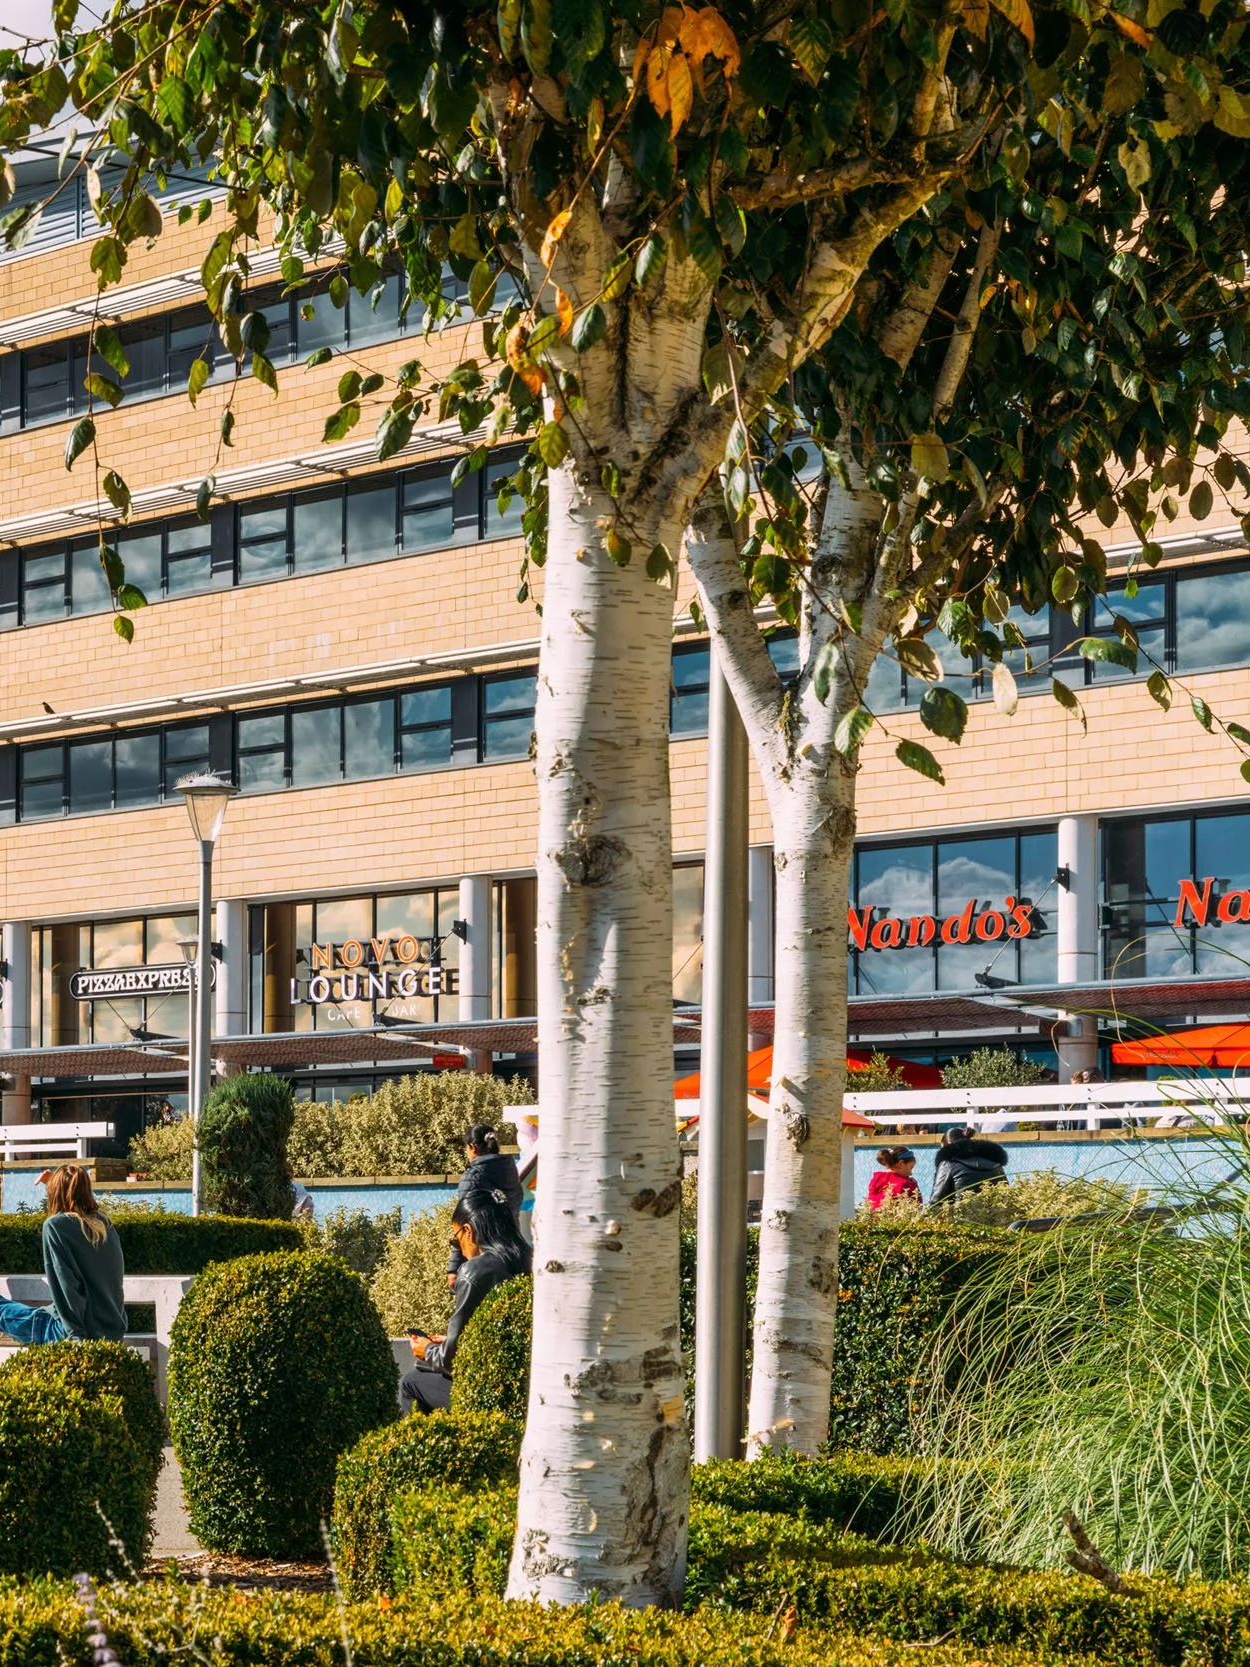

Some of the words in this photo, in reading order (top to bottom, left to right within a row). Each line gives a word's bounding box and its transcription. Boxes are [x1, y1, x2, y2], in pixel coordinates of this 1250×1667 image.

[847, 896, 1032, 951] Nando's
[313, 935, 419, 969] NOVO
[290, 967, 442, 1004] LOUNGE
